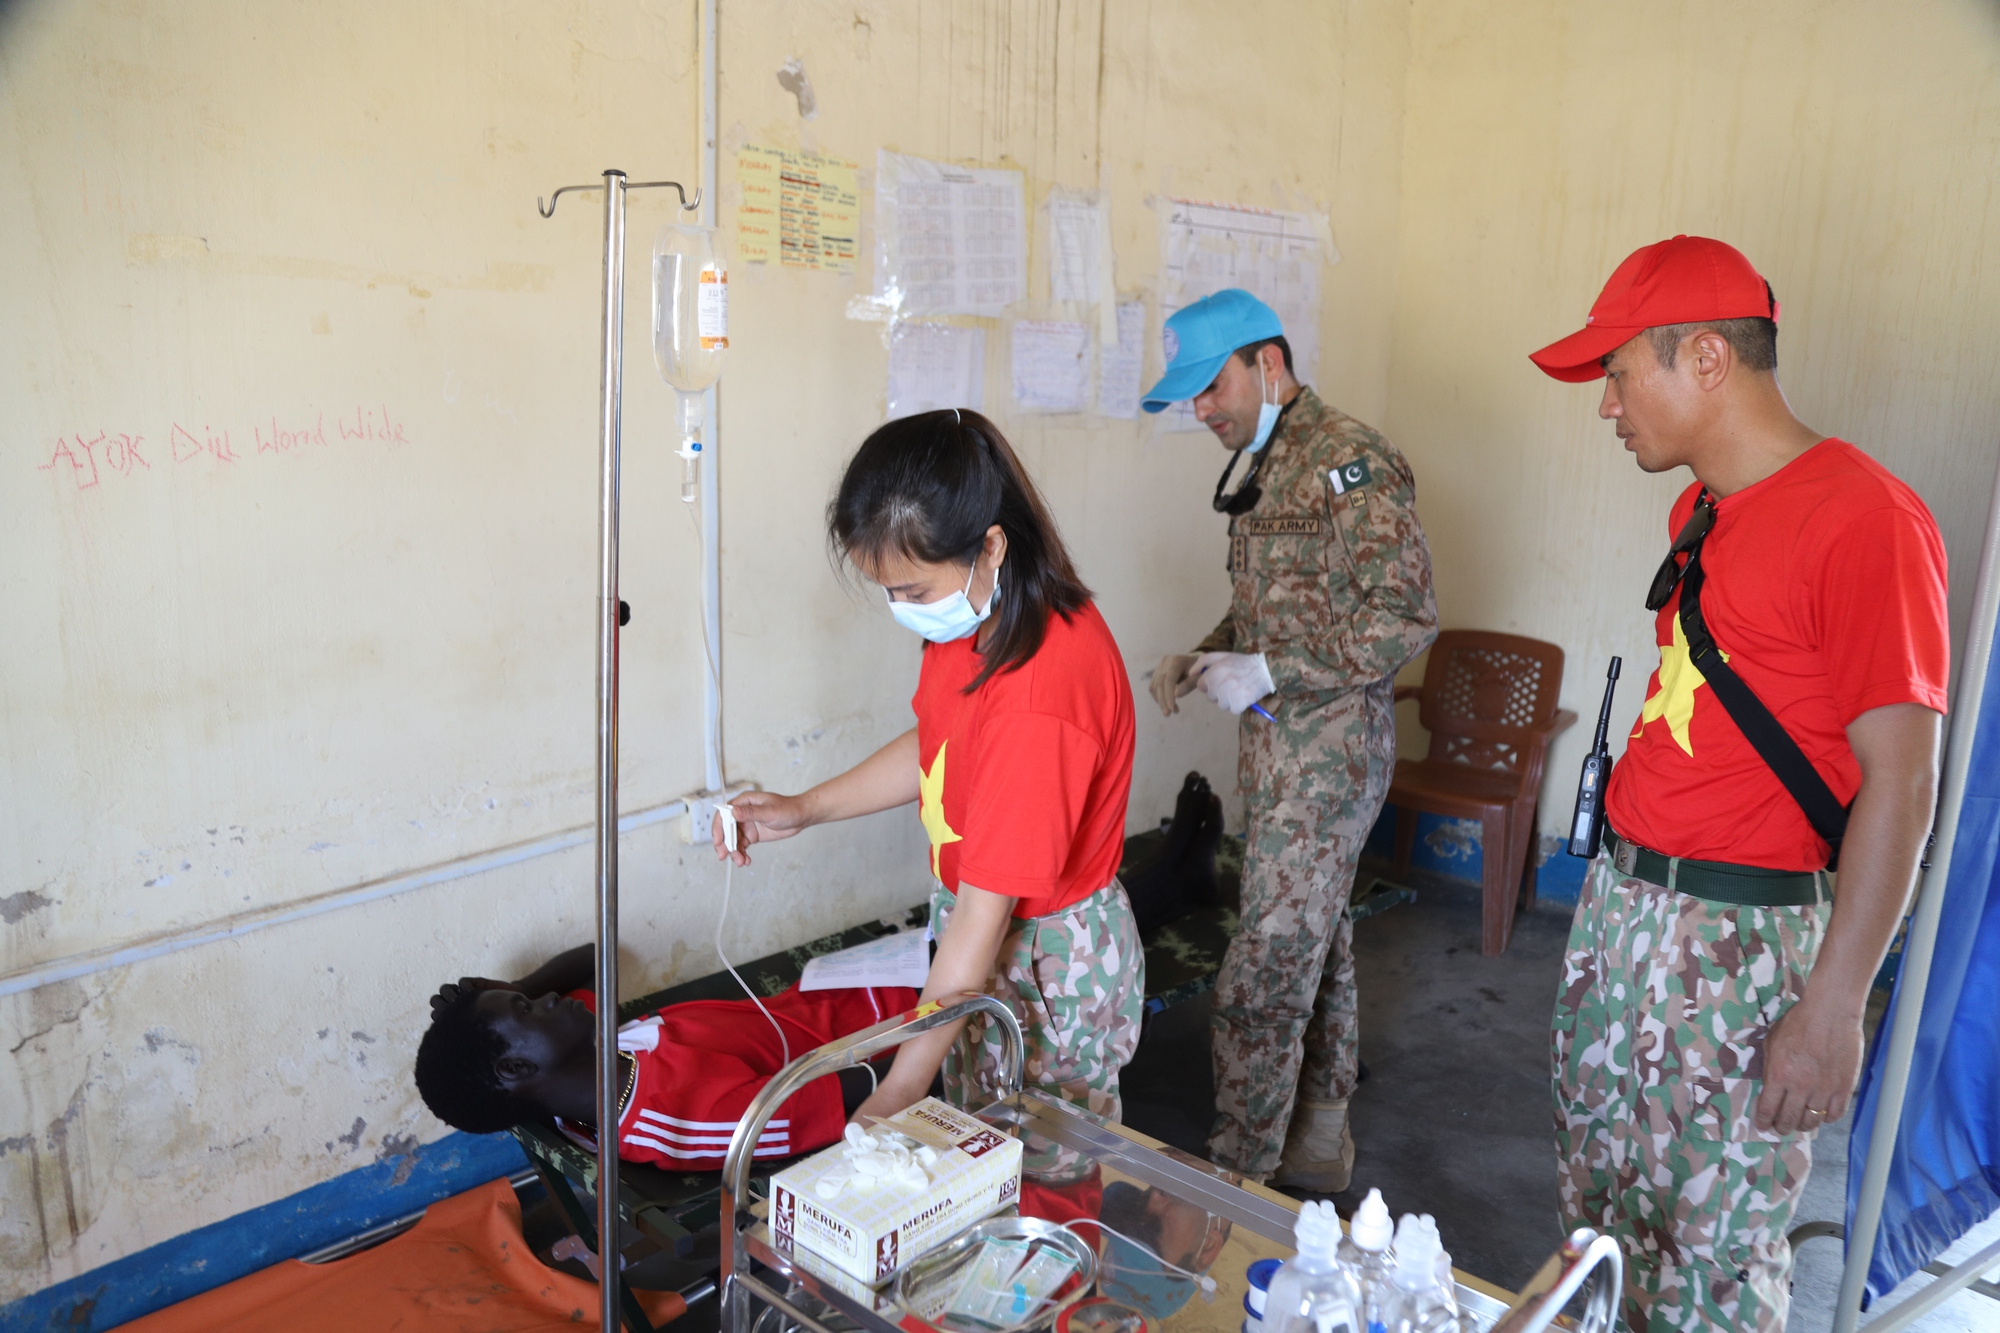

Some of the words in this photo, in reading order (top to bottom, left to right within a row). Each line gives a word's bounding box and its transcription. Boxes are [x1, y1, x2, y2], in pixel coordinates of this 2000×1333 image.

[1253, 521, 1275, 533] PAK
[1278, 520, 1315, 532] ARMY
[915, 1109, 965, 1136] MERUFA
[1000, 1176, 1017, 1196] 100
[802, 1203, 852, 1241] MERUFA
[902, 1197, 953, 1232] MERUFA
